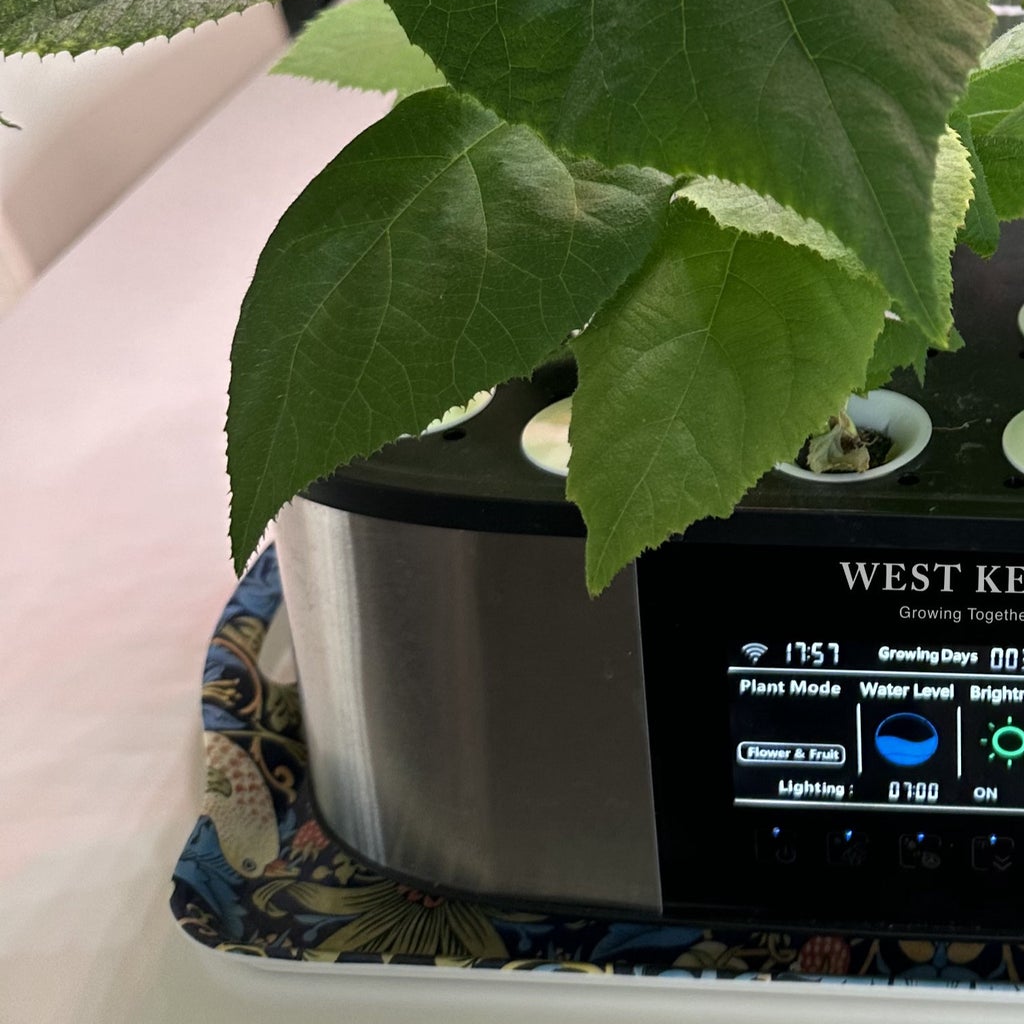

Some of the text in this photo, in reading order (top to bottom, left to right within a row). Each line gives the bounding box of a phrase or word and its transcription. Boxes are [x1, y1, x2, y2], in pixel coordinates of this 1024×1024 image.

[839, 562, 962, 593] WEST
[899, 606, 962, 623] Growing
[786, 642, 840, 665] 17:57
[878, 646, 939, 665] Growing
[941, 648, 979, 666] Days
[739, 679, 842, 697] Plant Mode
[859, 681, 955, 700] Water Level
[746, 746, 840, 761] Flower & Fruit
[888, 781, 940, 801] 07:00
[973, 787, 999, 803] ON
